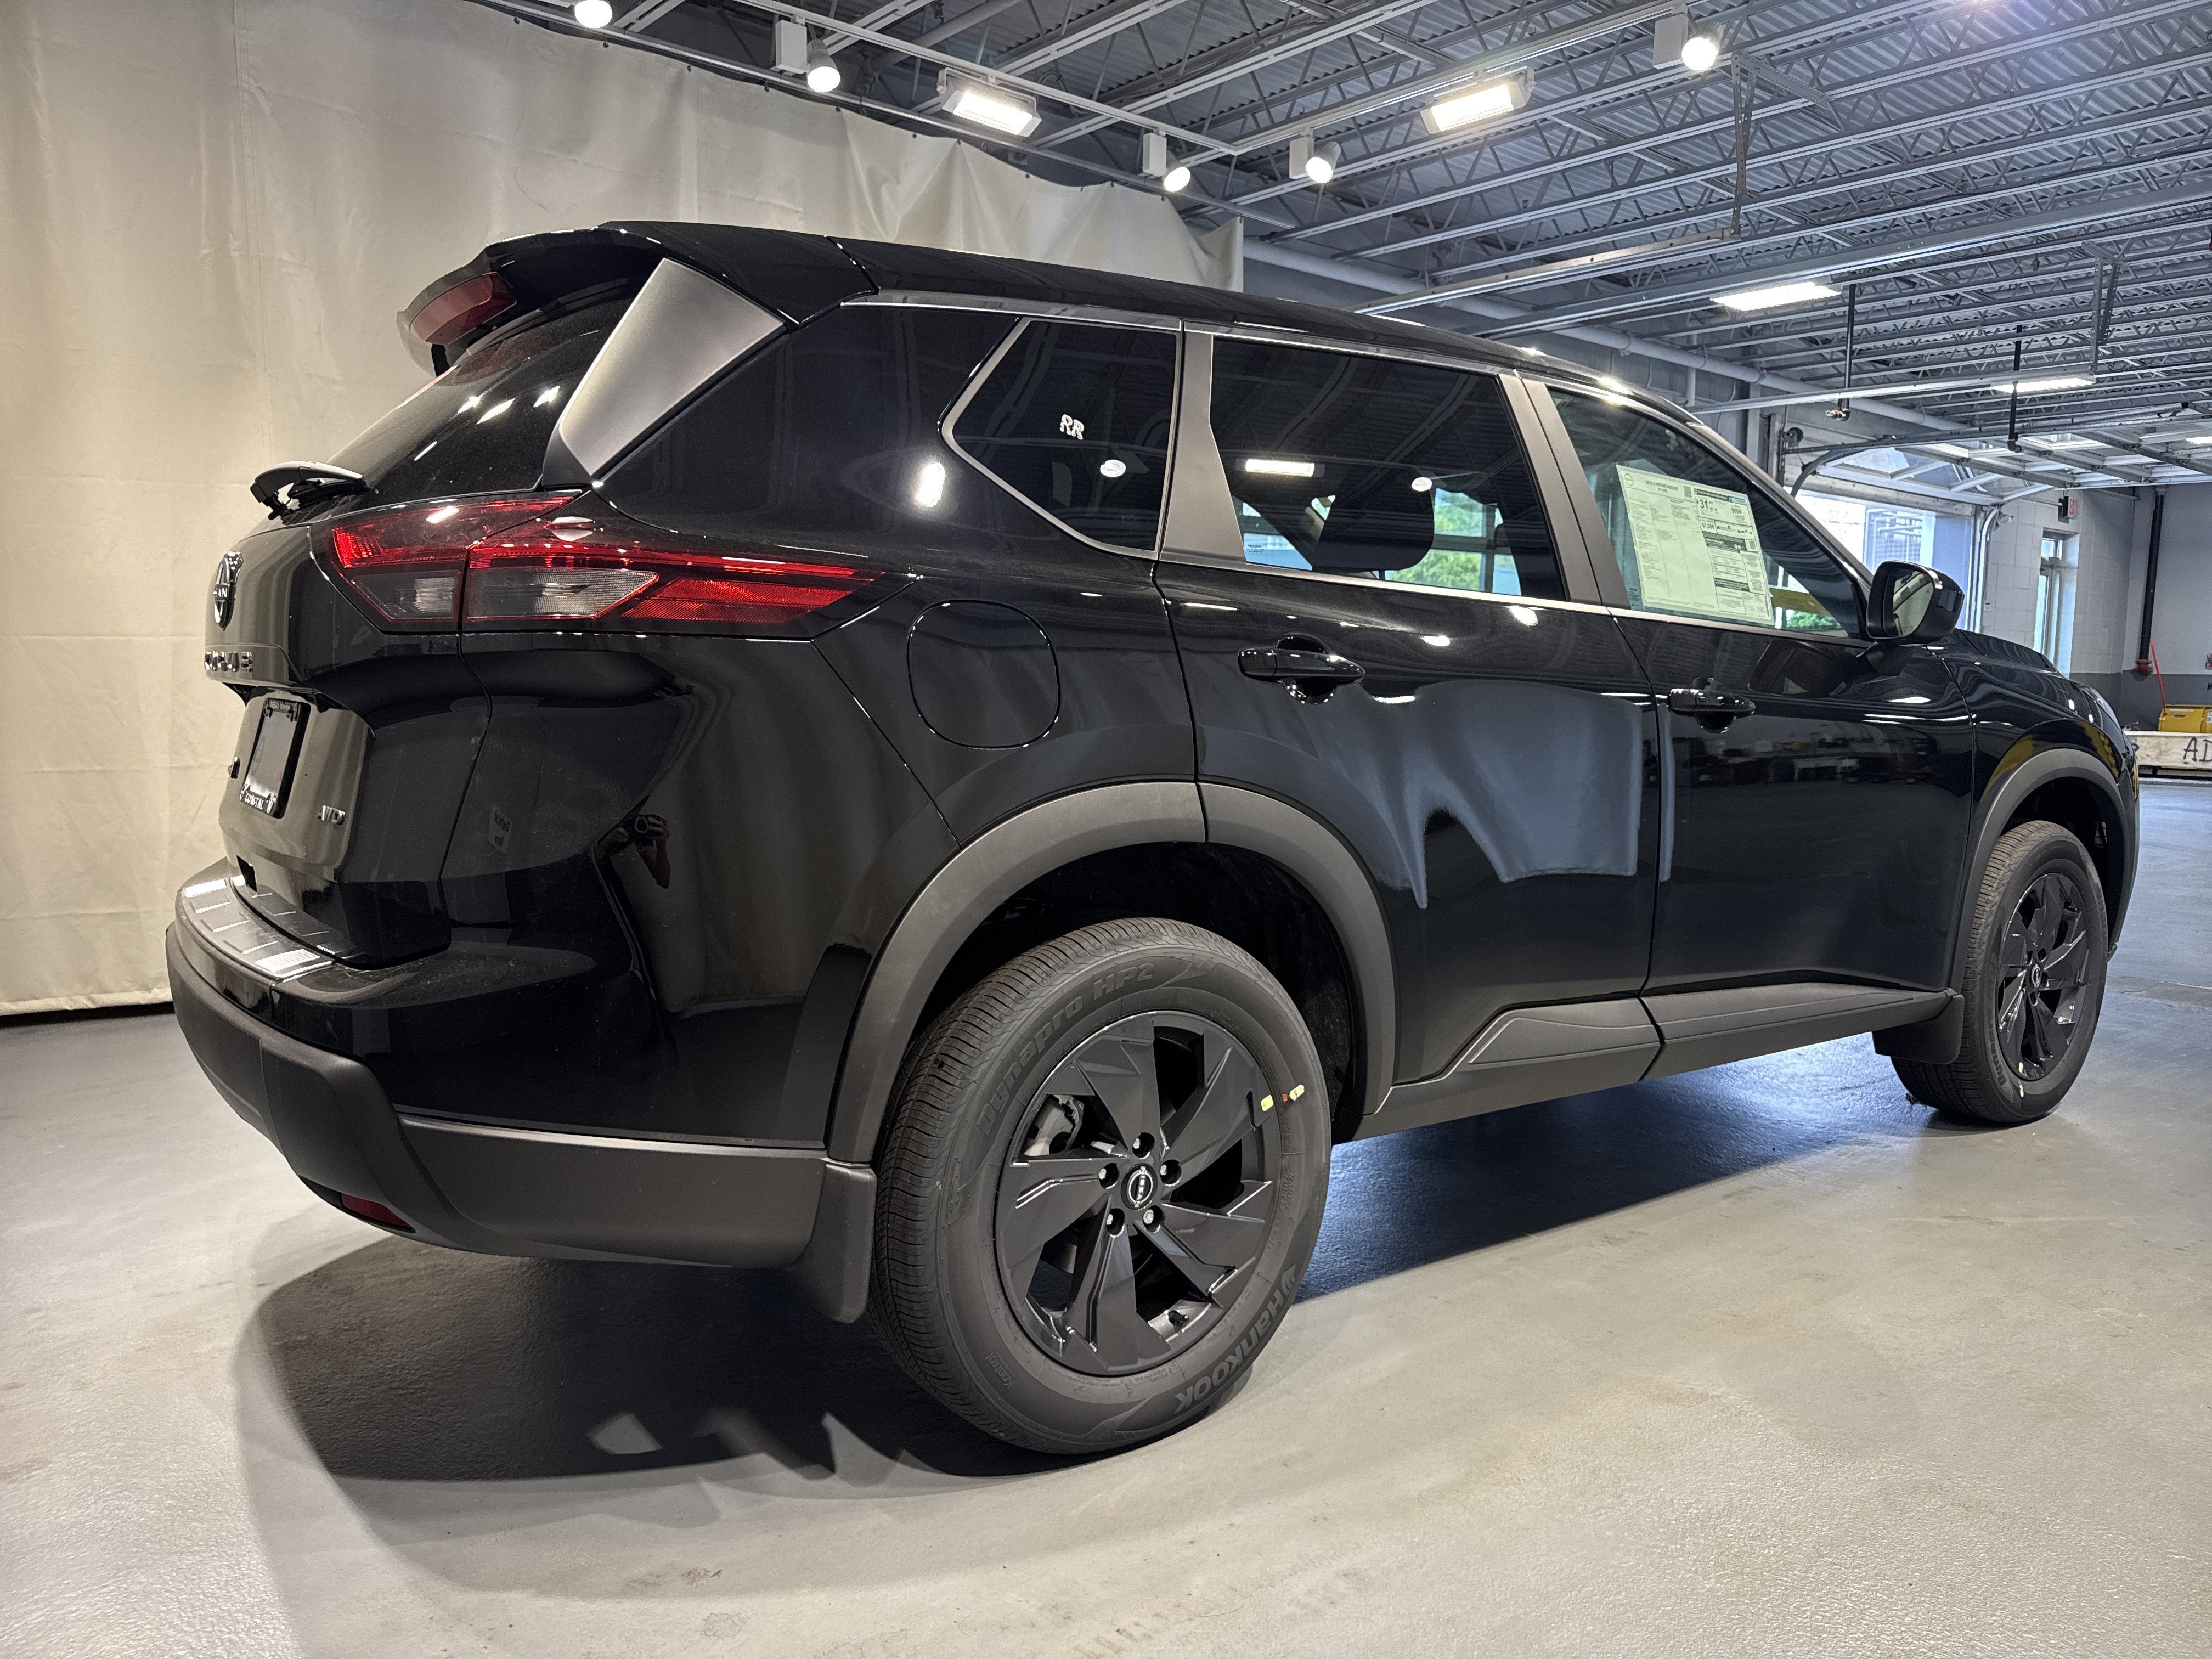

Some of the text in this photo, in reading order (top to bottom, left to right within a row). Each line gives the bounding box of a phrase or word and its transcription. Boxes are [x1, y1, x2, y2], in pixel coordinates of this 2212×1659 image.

[1700, 499, 1708, 510] 31
[245, 793, 263, 810] COASTAL
[978, 963, 1154, 1137] Dynapro HP2
[1135, 1166, 1146, 1208] NISSAN
[985, 1352, 1015, 1390] Kontrol
